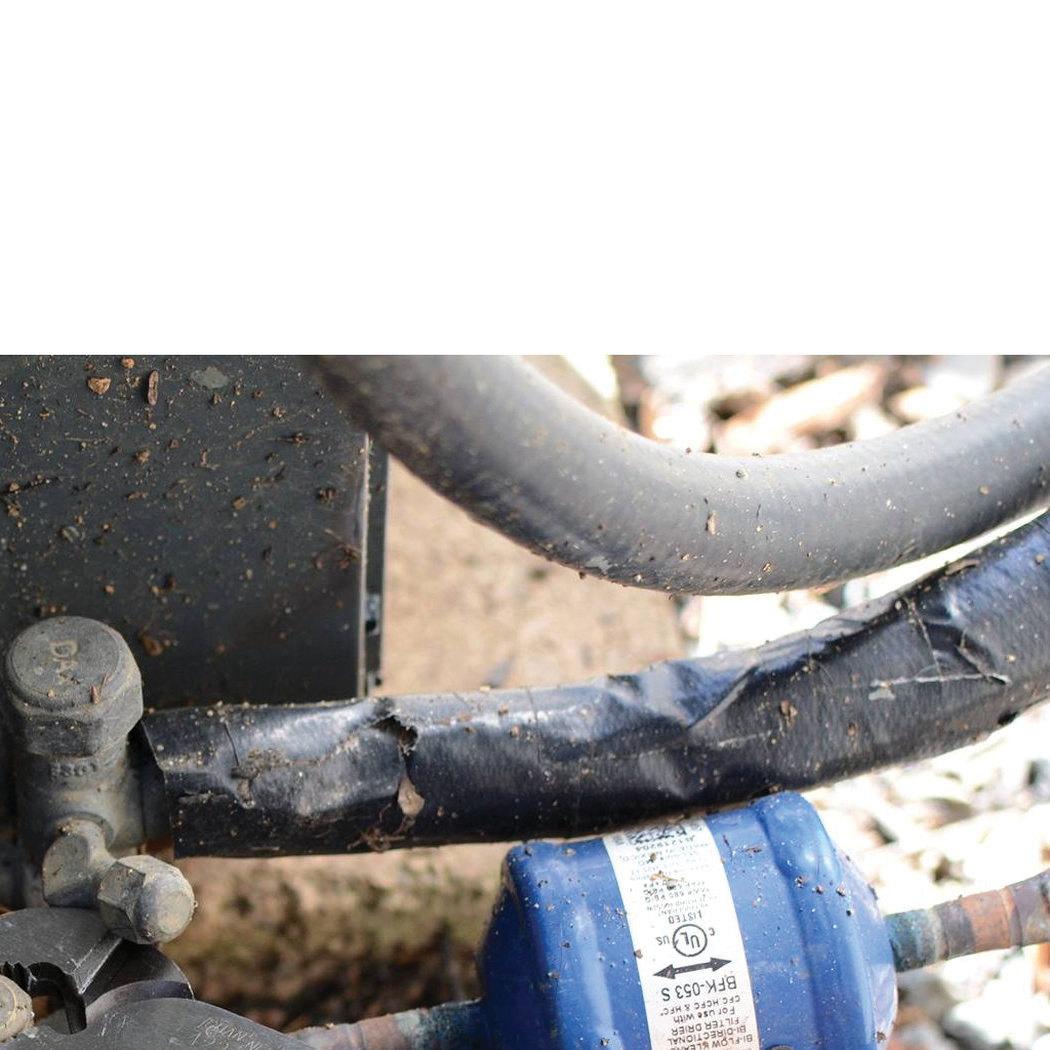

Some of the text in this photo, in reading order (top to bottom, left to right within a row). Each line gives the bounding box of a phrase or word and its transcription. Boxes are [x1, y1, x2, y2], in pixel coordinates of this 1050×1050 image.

[668, 910, 702, 924] LISTED
[656, 936, 670, 945] US
[661, 975, 737, 1001] BFK-053 S
[673, 1006, 735, 1023] For use with
[667, 1025, 746, 1045] BI-DIRECTIONAL
[671, 1017, 739, 1036] FILTER DRIER
[712, 1034, 753, 1048] BI-FLOW
